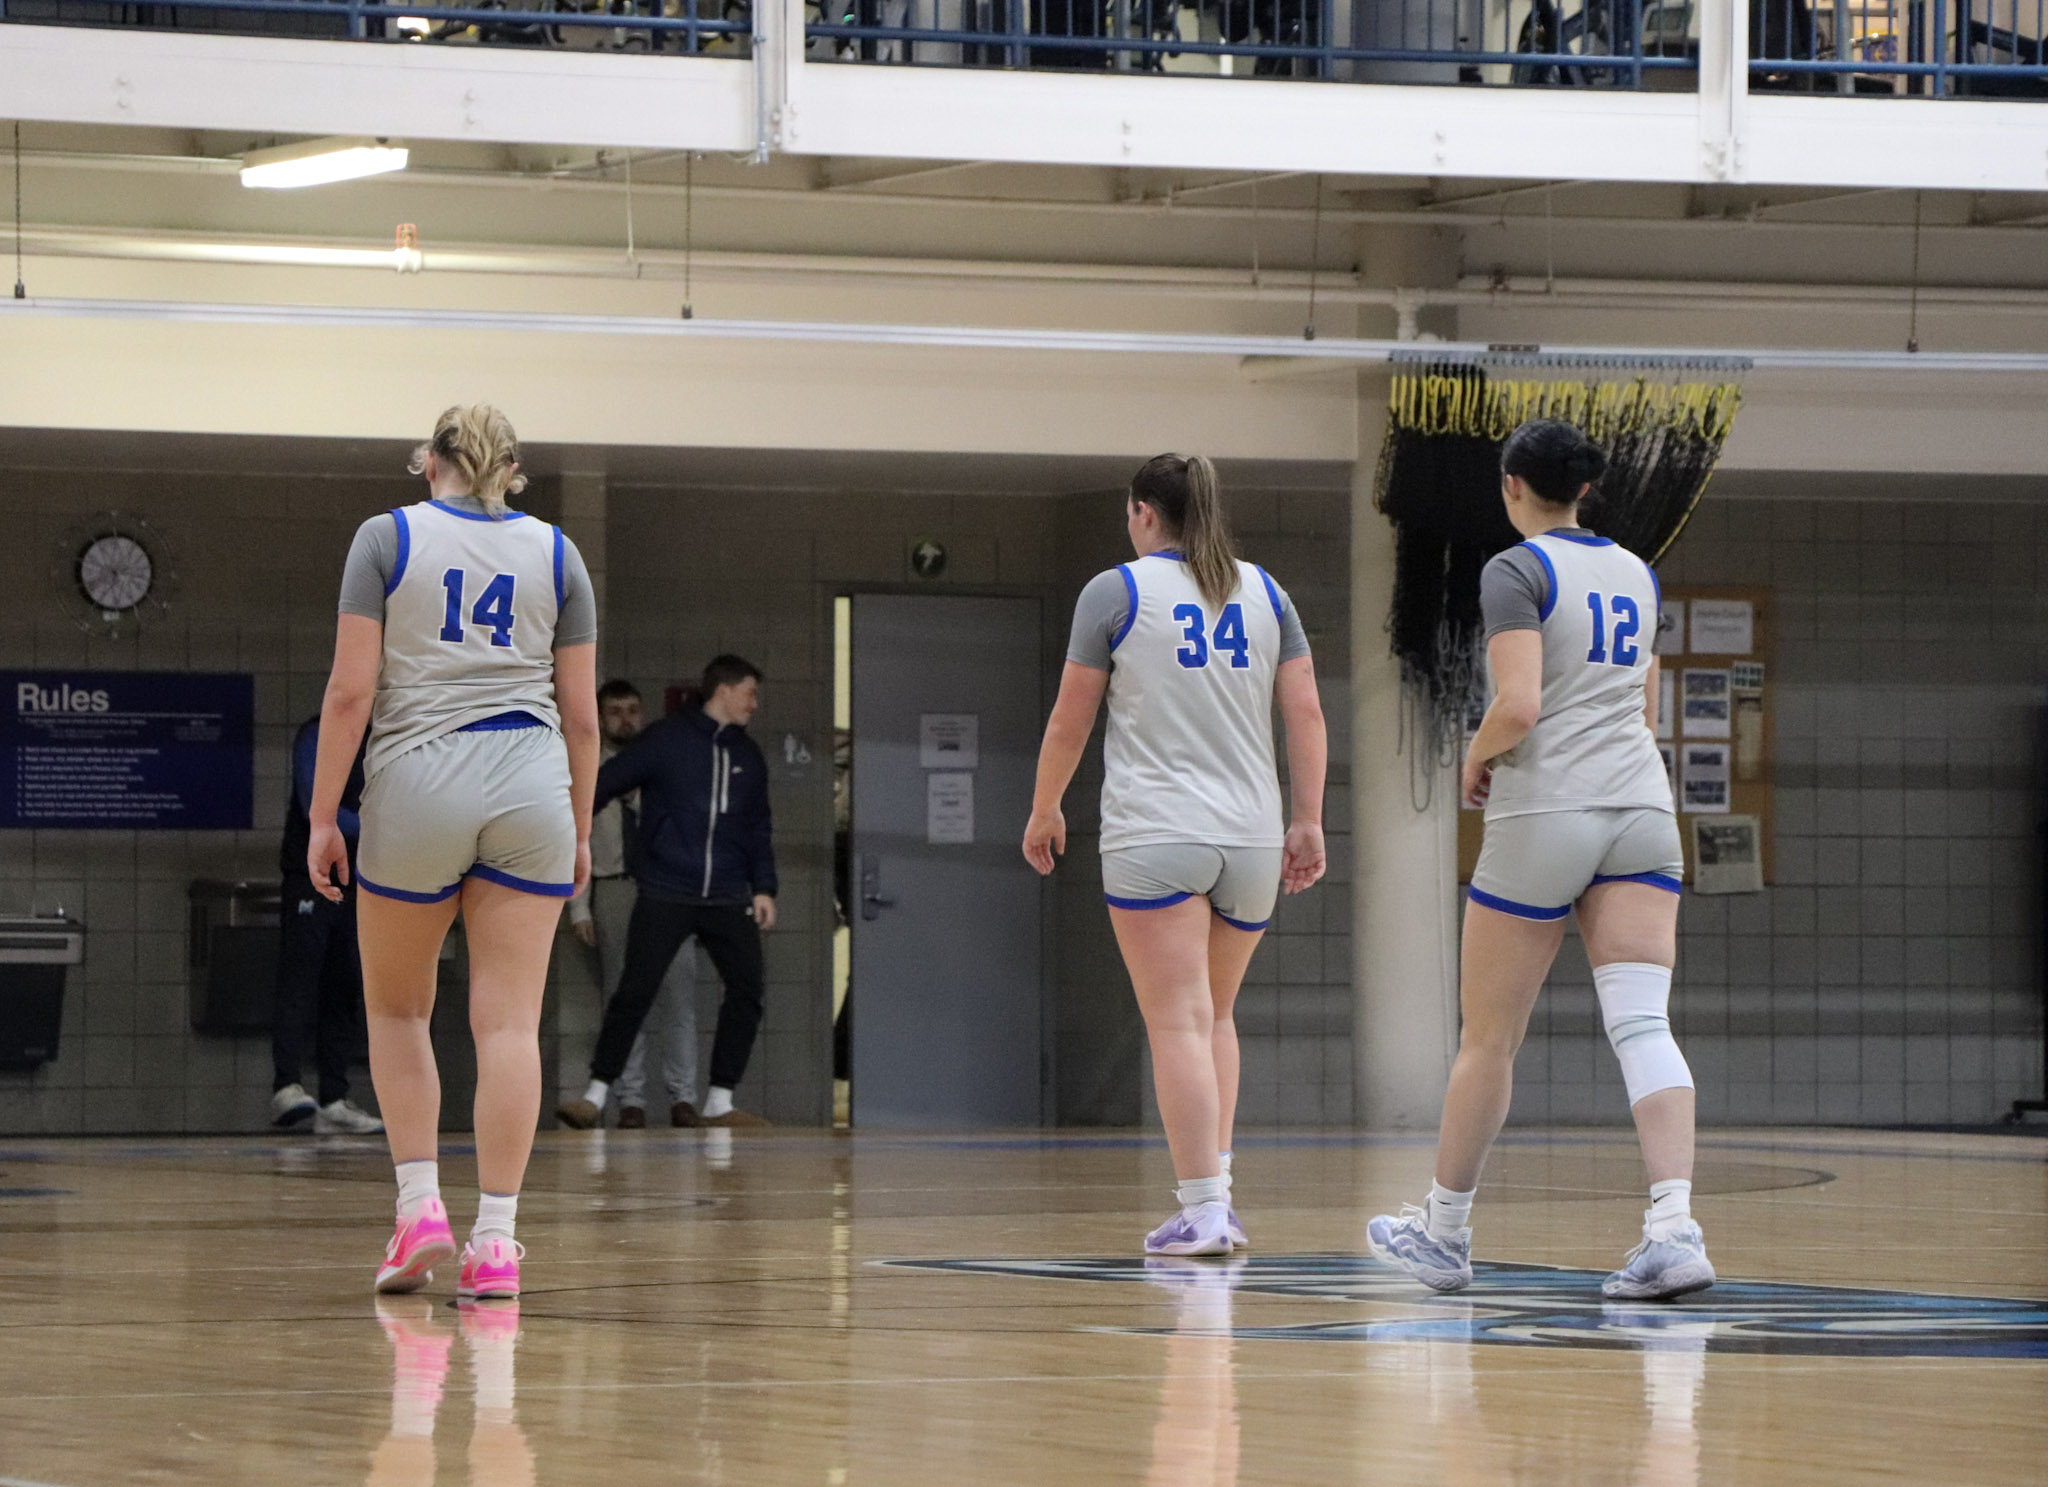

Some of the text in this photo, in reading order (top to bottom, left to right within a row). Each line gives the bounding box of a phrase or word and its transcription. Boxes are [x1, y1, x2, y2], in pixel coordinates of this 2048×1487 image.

[439, 567, 516, 648] 14
[1171, 602, 1250, 670] 34
[1585, 590, 1640, 668] 12
[17, 682, 110, 713] Rules
